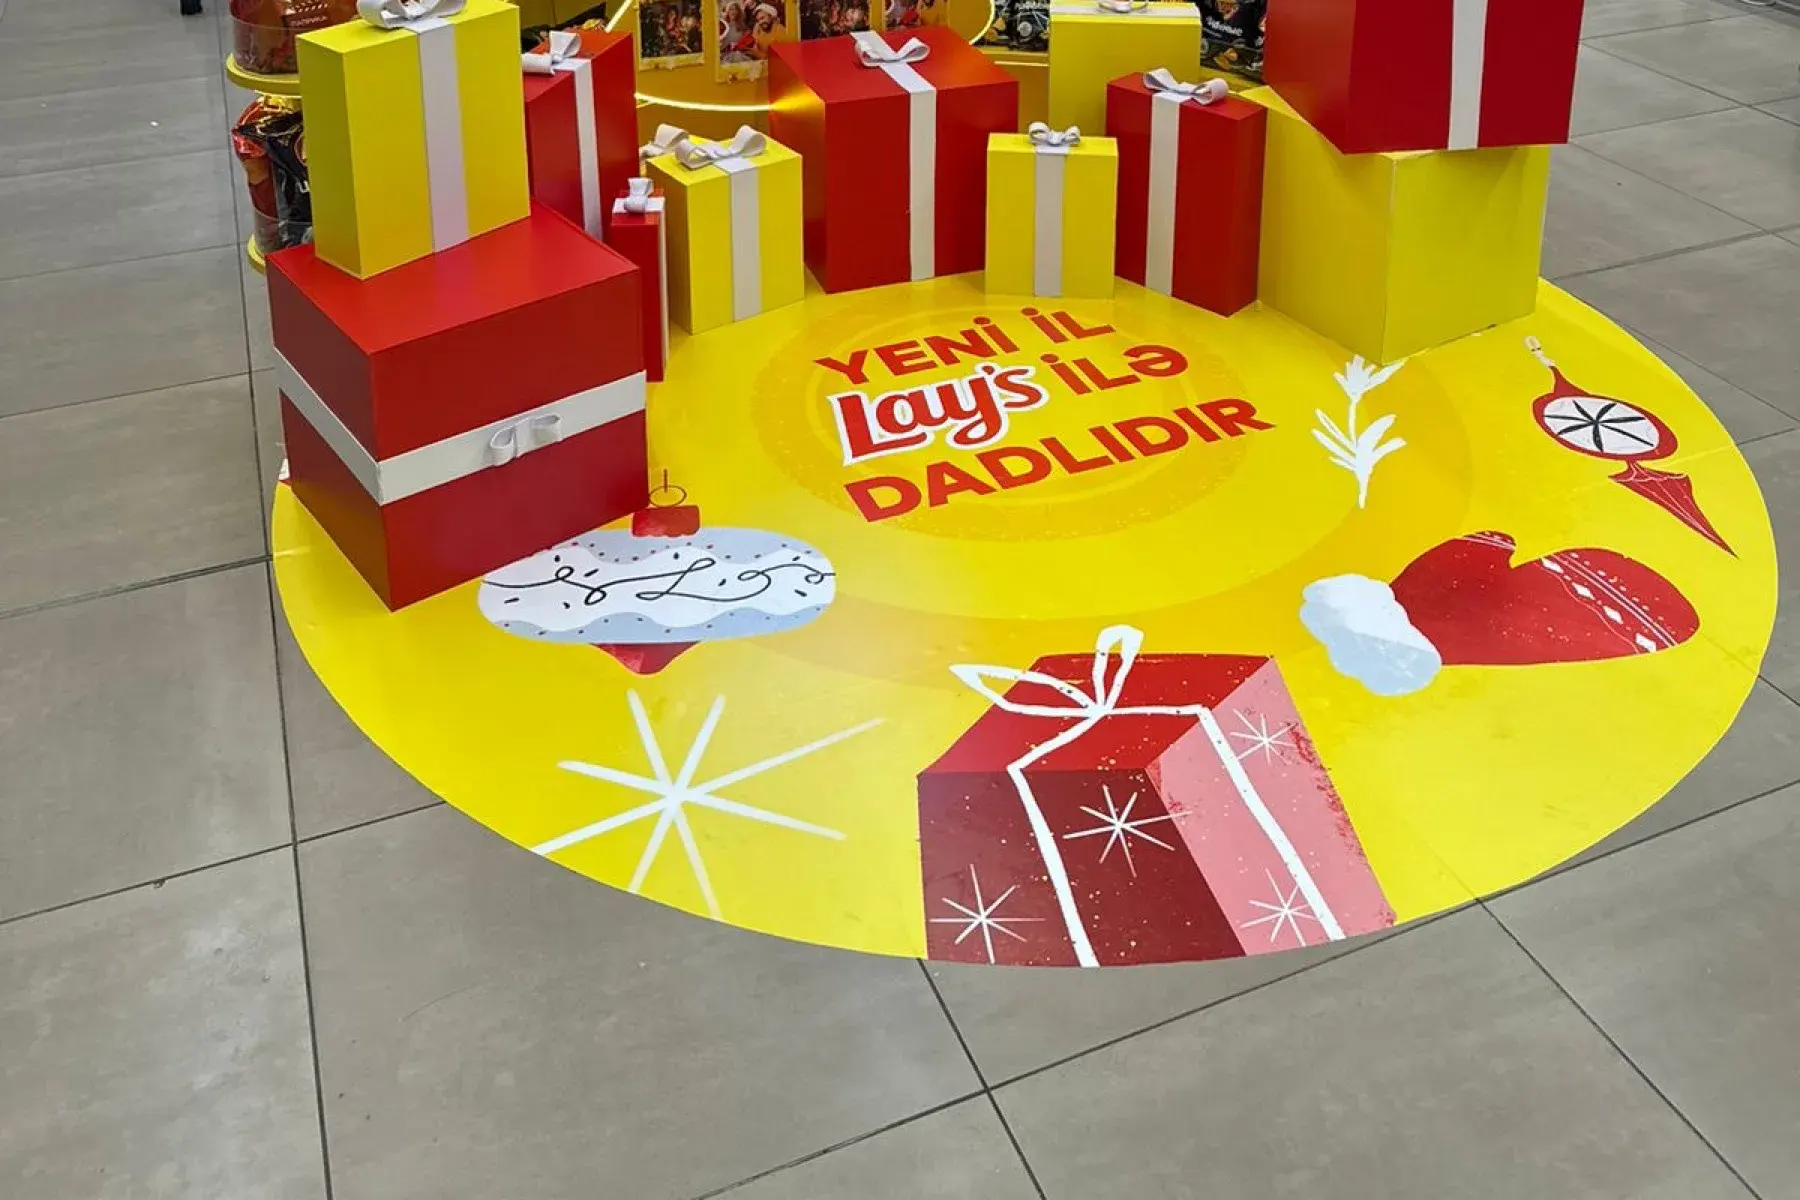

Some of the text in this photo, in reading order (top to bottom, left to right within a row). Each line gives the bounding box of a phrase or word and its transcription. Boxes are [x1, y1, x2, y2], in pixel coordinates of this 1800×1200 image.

[813, 307, 1117, 385] YENİ İL
[830, 362, 1046, 462] Lay's
[844, 398, 1277, 523] DADLIDIR
